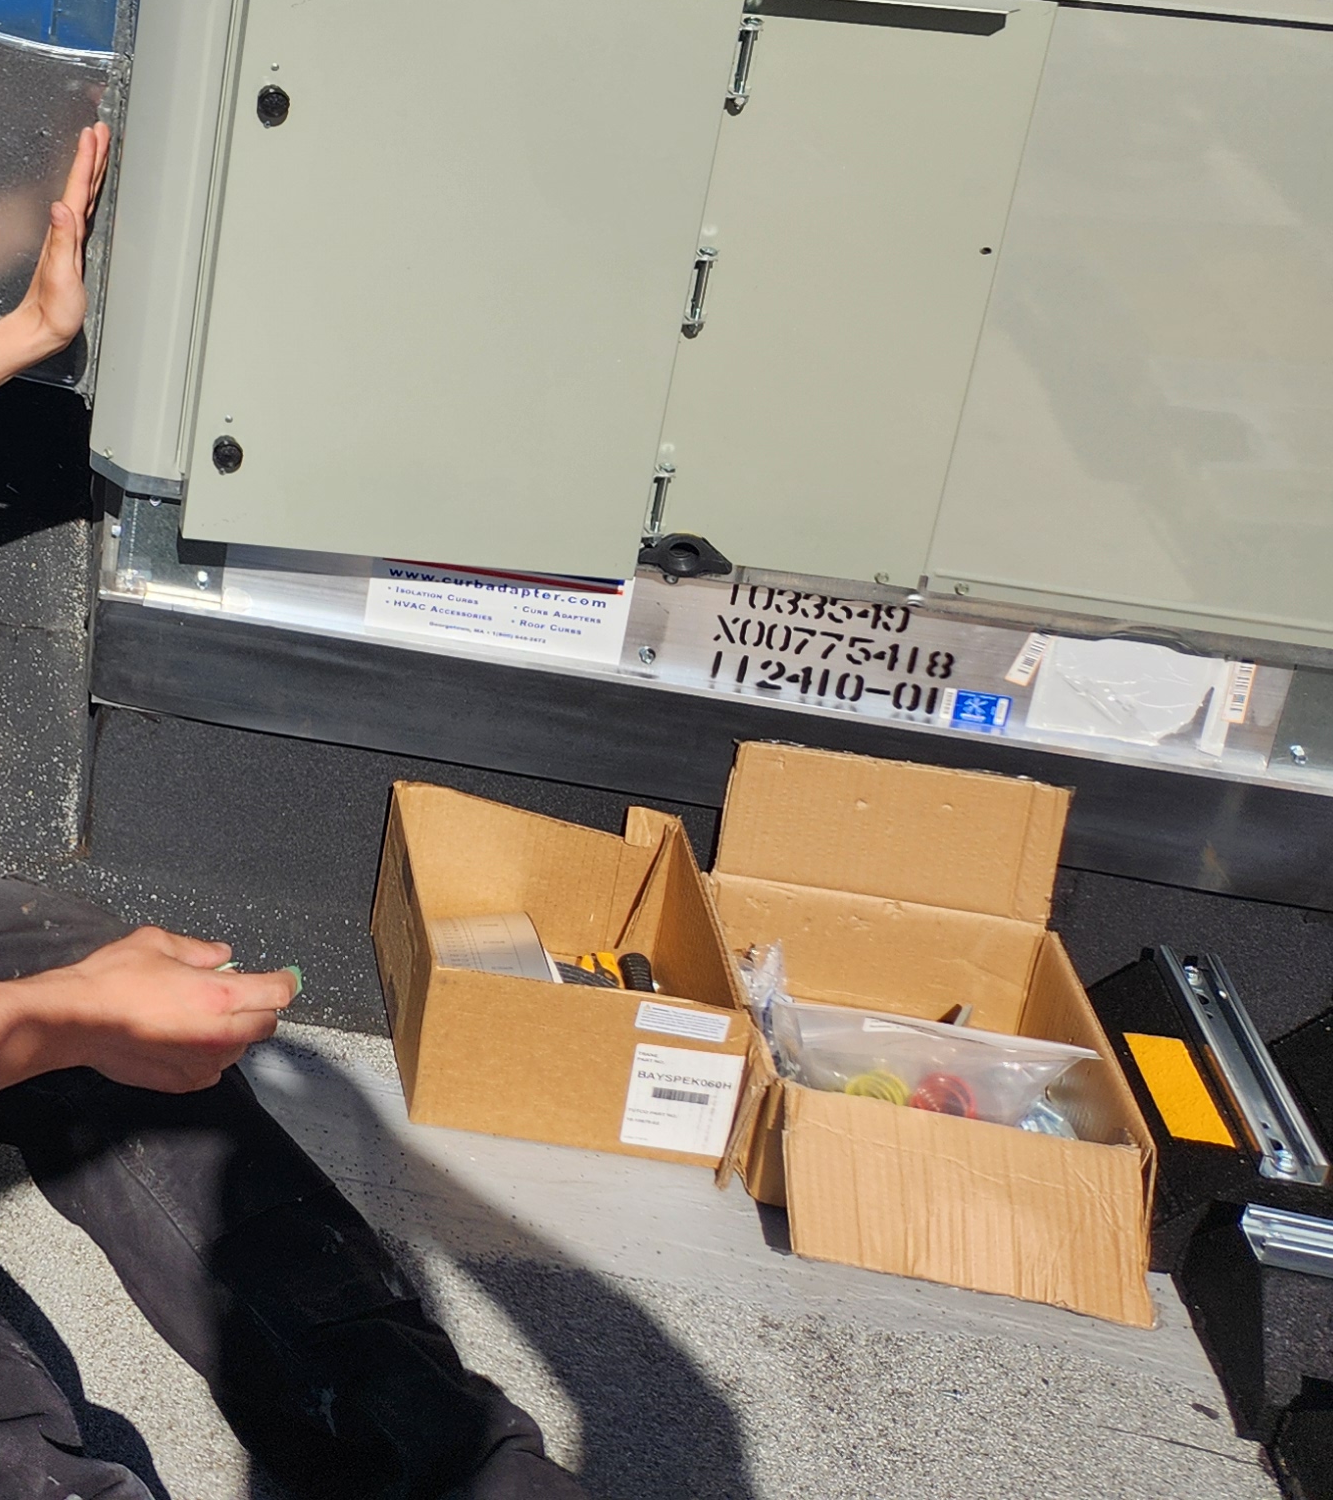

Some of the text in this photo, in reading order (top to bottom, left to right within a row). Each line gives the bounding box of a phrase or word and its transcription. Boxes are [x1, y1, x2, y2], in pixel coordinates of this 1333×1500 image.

[388, 567, 608, 609] www.curbadapter.com
[394, 600, 426, 611] HVAC
[713, 614, 956, 680] X00775418
[711, 650, 939, 715] 112410-01
[637, 1070, 732, 1090] BAYSPEK060H
